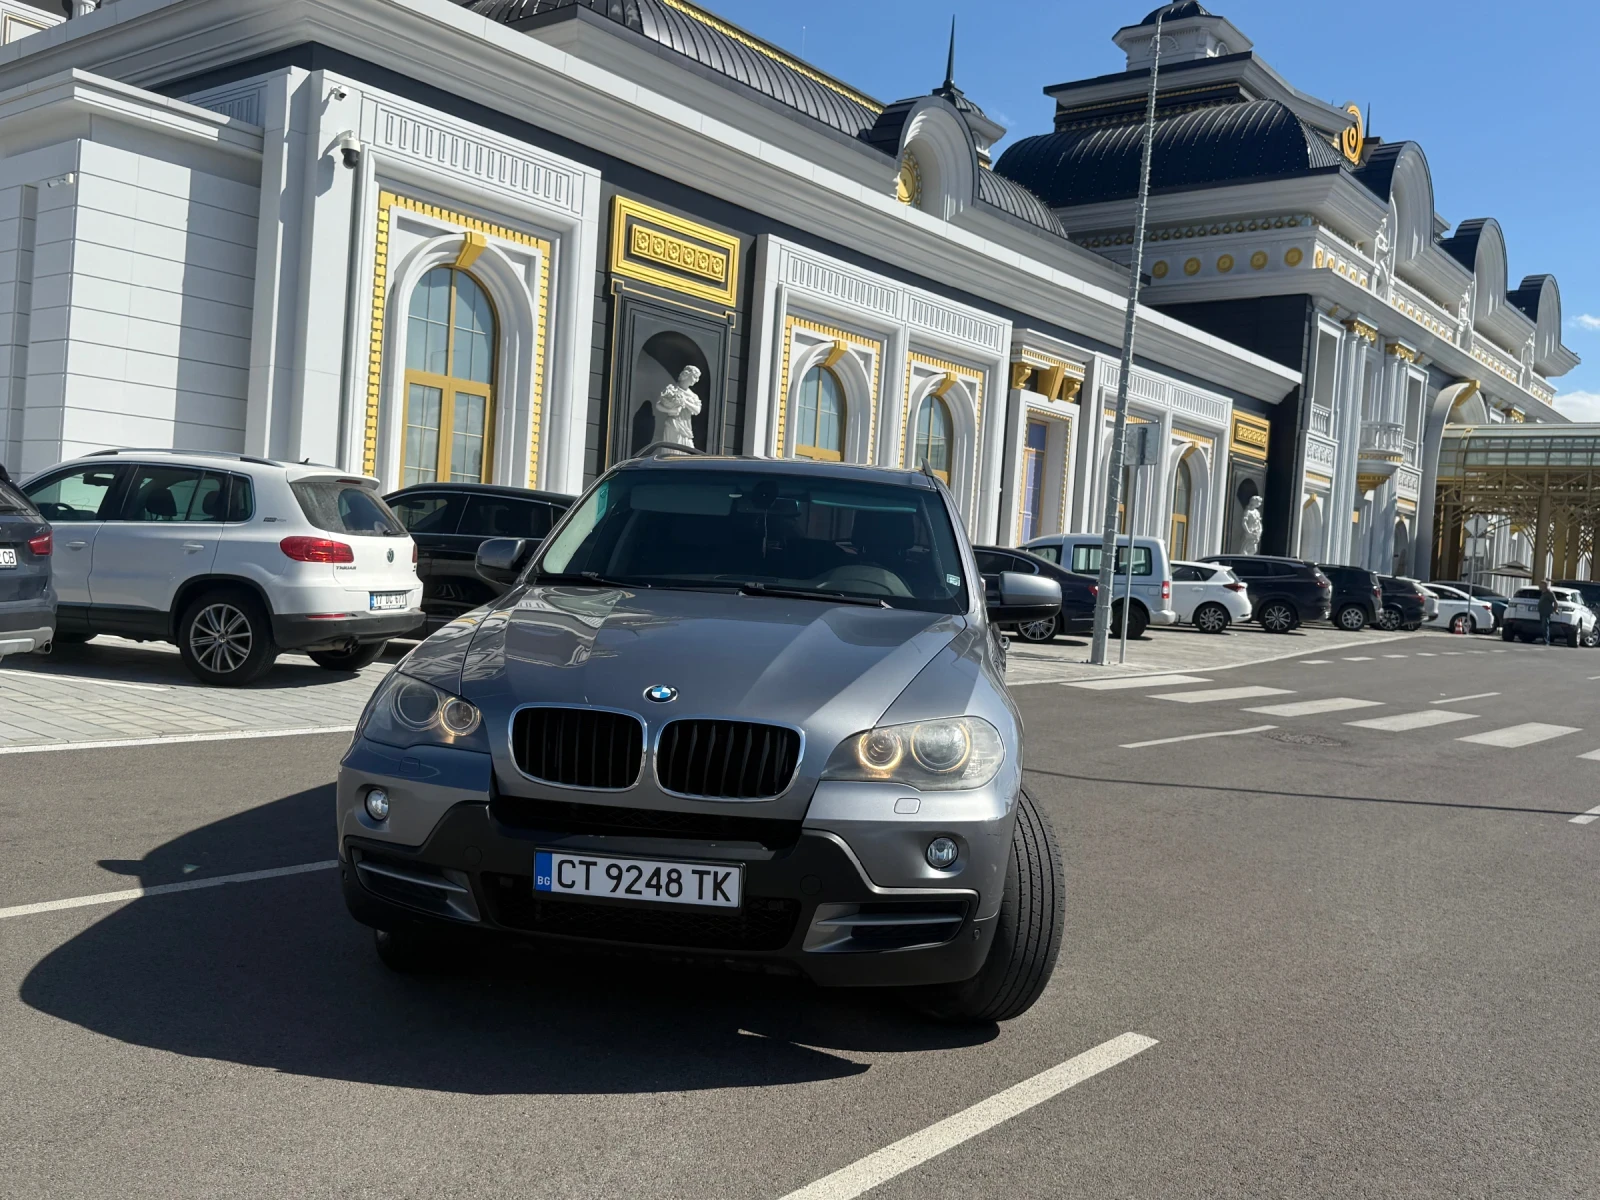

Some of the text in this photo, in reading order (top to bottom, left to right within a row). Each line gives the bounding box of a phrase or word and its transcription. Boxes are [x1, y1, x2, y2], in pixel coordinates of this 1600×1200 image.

[537, 876, 551, 886] BG
[557, 859, 732, 902] CT 9248 TK
